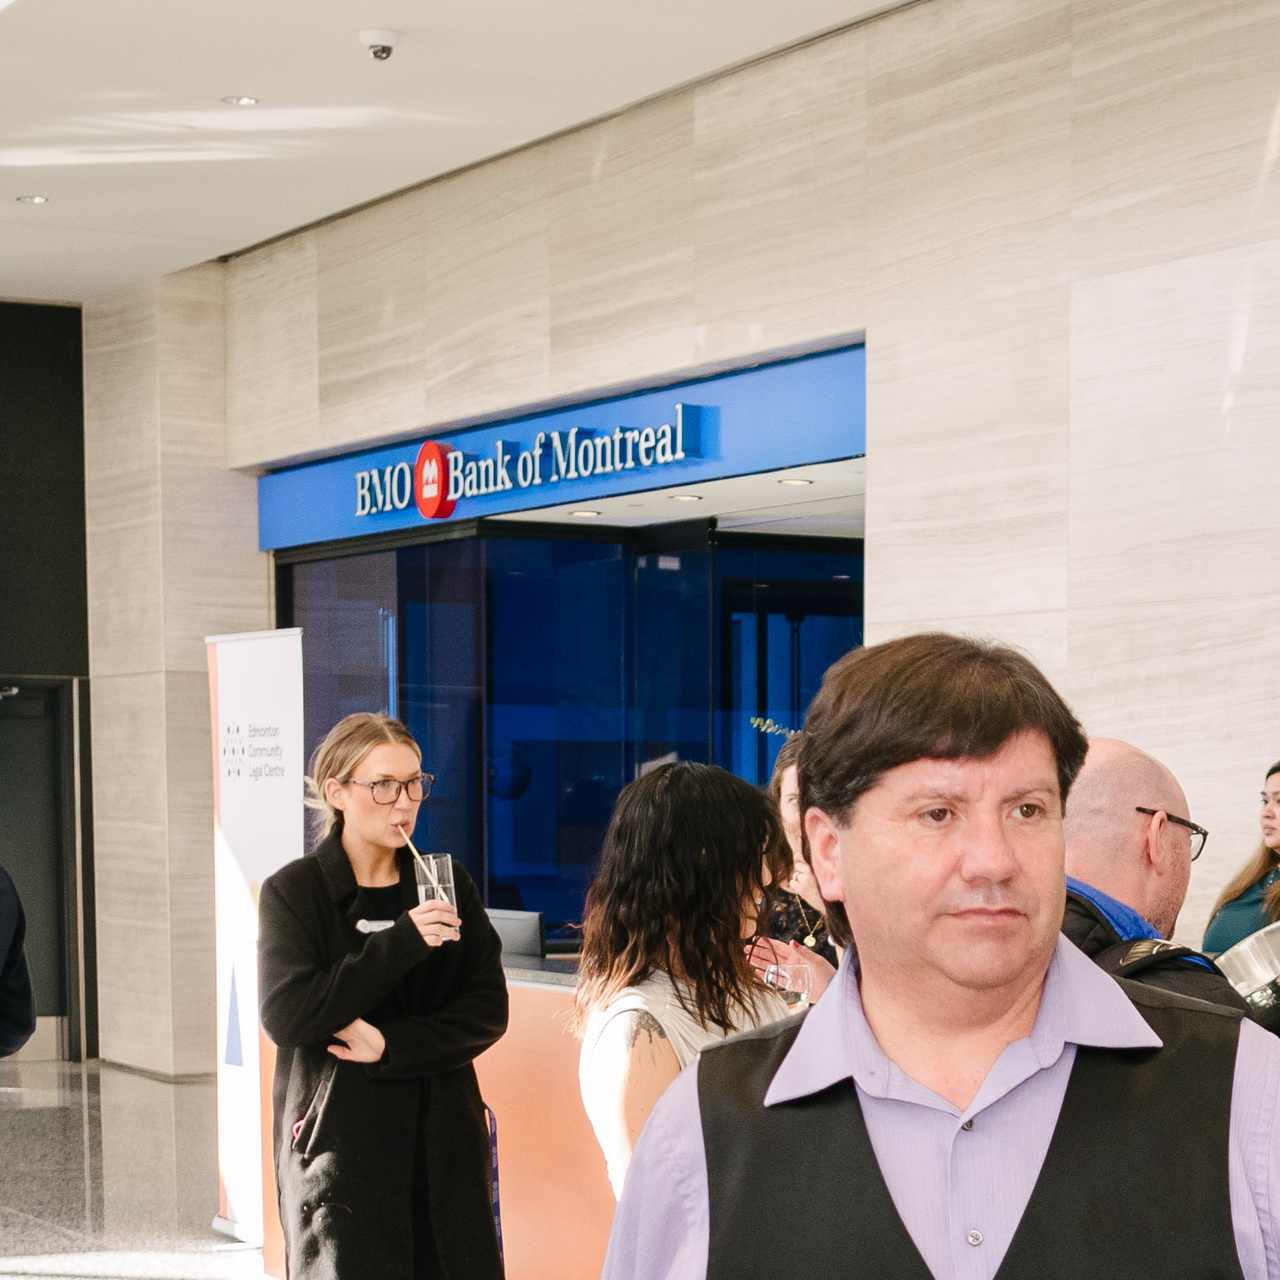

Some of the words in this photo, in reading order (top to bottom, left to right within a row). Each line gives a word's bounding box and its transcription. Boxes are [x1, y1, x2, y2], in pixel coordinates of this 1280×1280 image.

[355, 462, 411, 516] BMO
[447, 440, 512, 501] Bank
[517, 432, 544, 488] of
[550, 403, 685, 482] Montreal
[249, 724, 279, 738] Edmonton
[249, 744, 283, 761] Community
[249, 763, 263, 781] Legal
[264, 763, 286, 777] Centre
